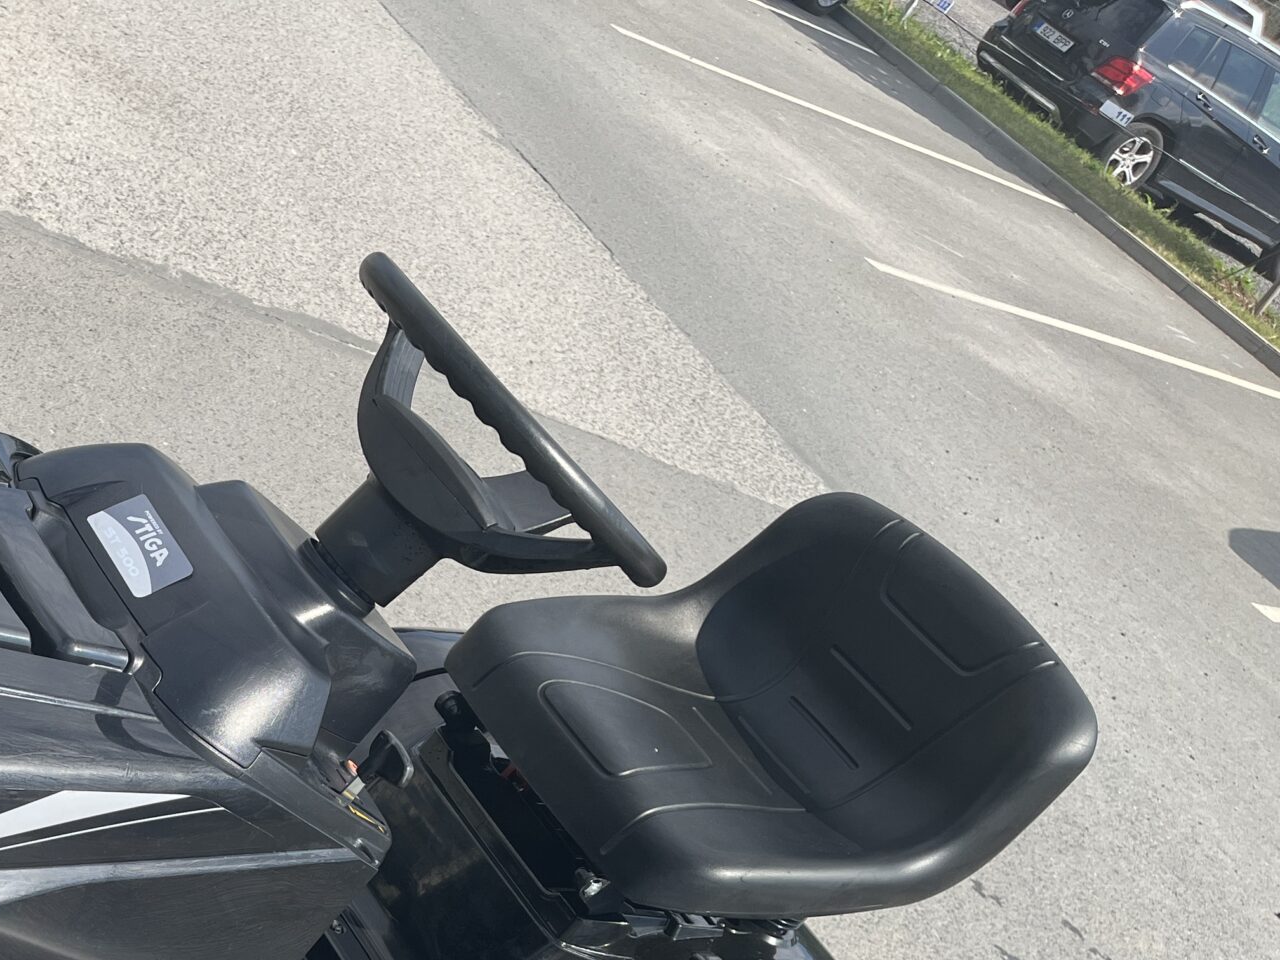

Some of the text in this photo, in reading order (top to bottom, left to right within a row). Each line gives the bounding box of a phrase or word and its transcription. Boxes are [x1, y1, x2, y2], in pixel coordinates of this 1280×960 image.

[1115, 111, 1132, 125] 111
[103, 527, 140, 577] ST 500
[126, 515, 169, 567] STIGA
